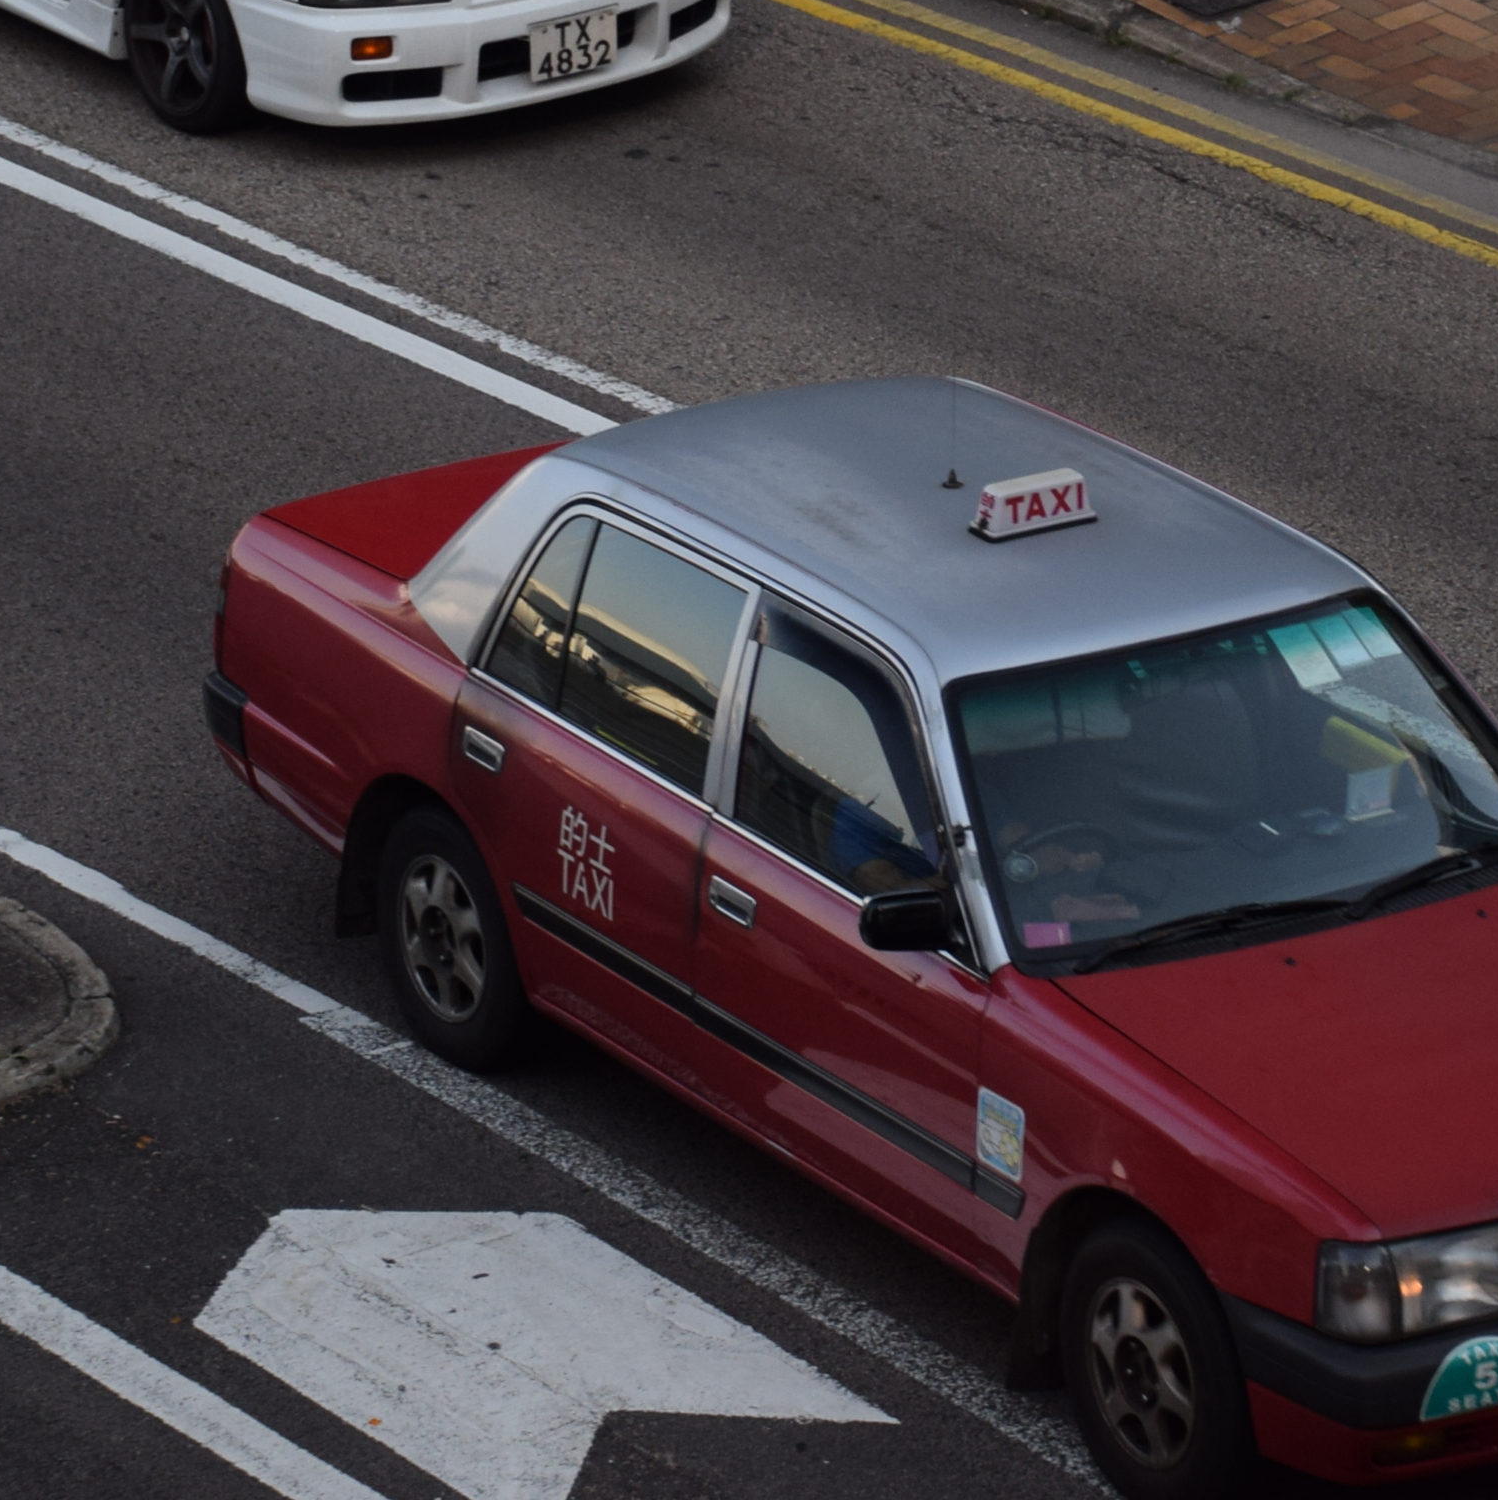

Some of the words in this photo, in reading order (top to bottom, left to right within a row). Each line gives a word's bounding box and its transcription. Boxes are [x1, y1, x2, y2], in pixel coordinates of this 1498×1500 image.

[554, 16, 591, 48] TX
[538, 39, 611, 78] 4832
[1005, 482, 1085, 524] TAXI
[558, 804, 615, 875] 的士
[557, 847, 614, 921] TAXI
[1474, 1360, 1498, 1390] 5
